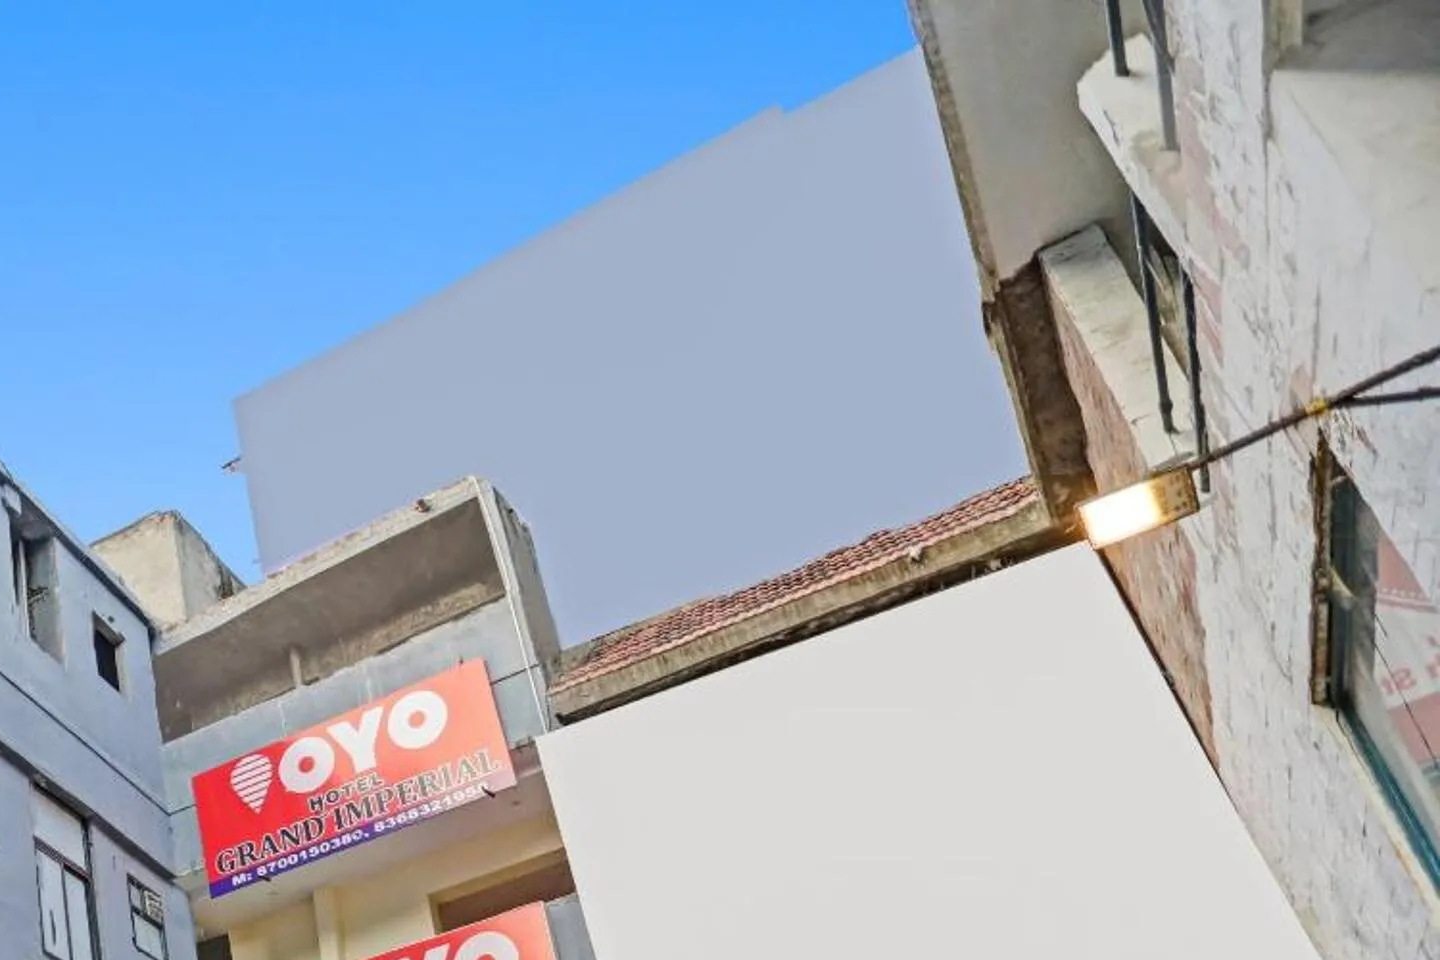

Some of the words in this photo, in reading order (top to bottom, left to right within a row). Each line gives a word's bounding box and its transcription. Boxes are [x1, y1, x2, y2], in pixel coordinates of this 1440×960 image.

[278, 690, 448, 794] OYO
[216, 813, 326, 875] GRAND
[334, 748, 500, 833] IMPERIAL
[309, 771, 383, 813] HOTEL
[231, 872, 253, 887] M:
